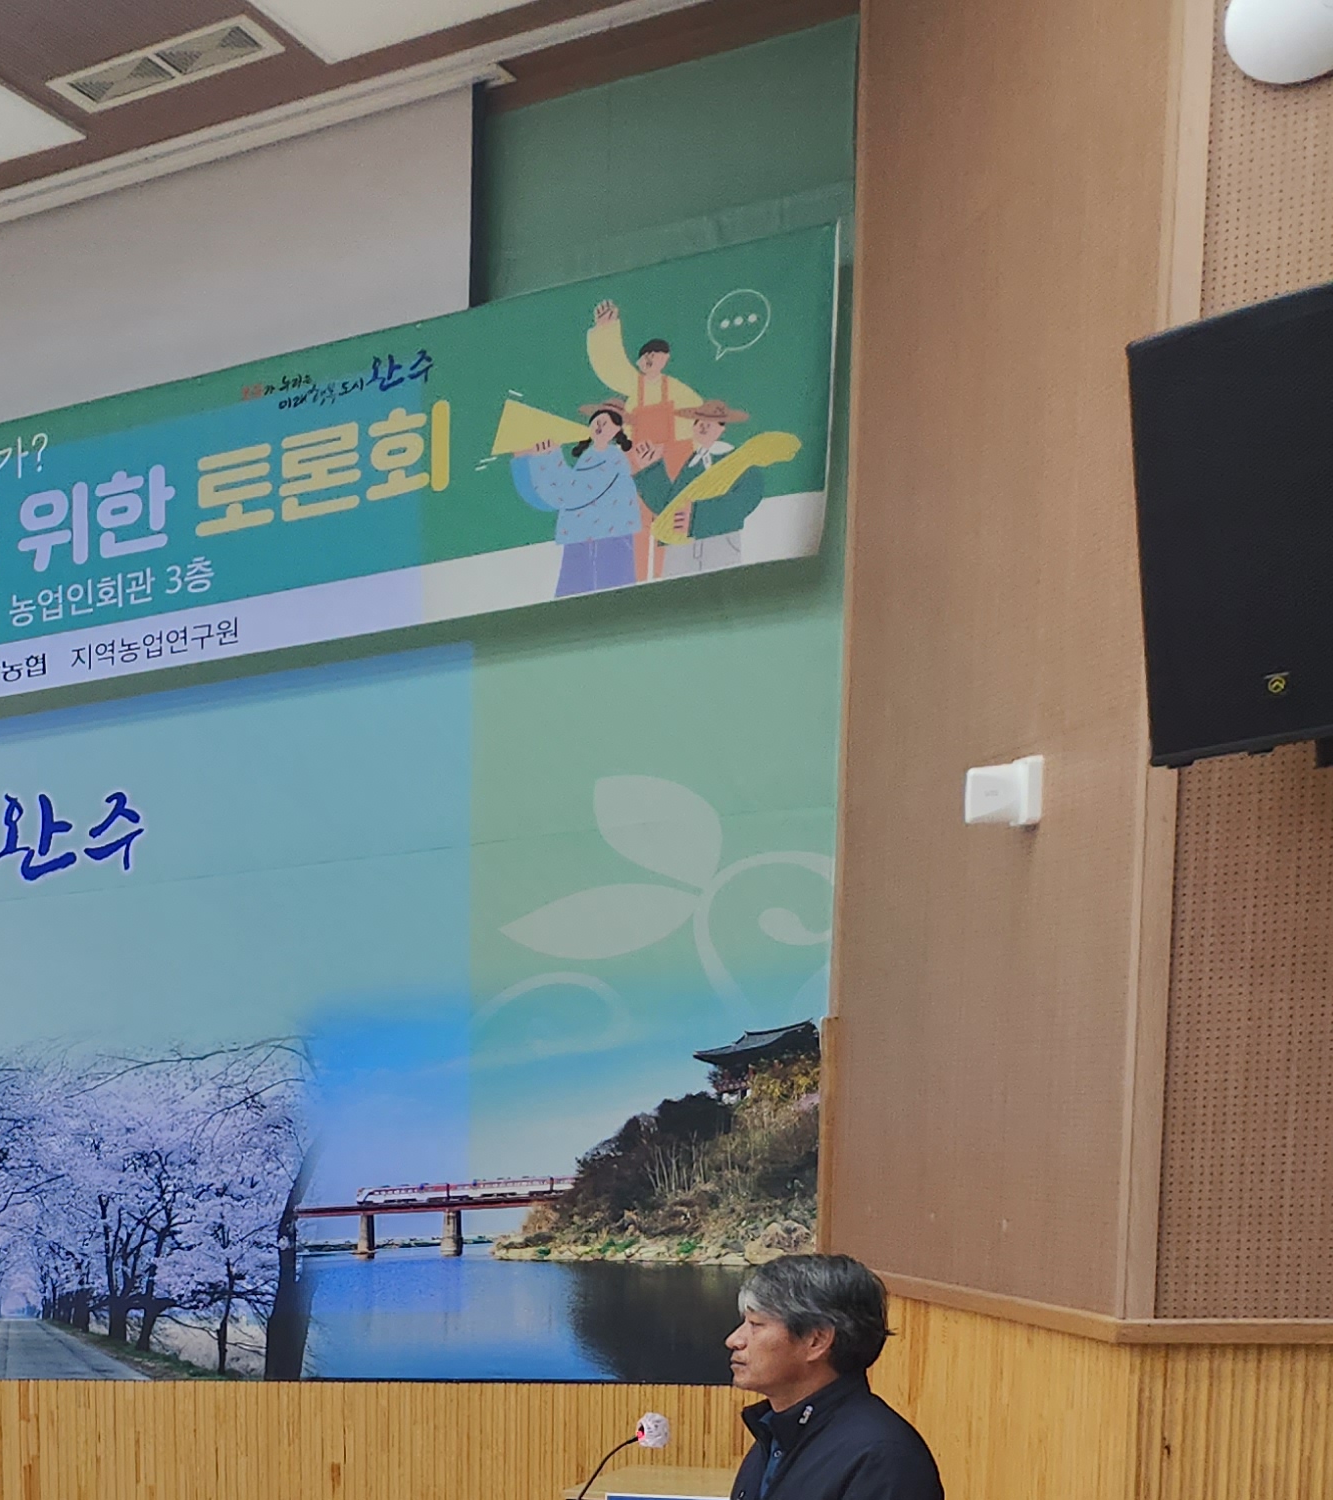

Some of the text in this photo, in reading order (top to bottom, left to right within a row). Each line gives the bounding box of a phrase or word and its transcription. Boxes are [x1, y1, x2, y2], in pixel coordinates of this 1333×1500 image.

[367, 349, 434, 392] 완주
[17, 464, 175, 573] 위한
[195, 399, 451, 537] 토론회
[9, 567, 156, 628] 농업인회관
[165, 556, 215, 595] 3층
[70, 616, 240, 671] 지역농업연구원
